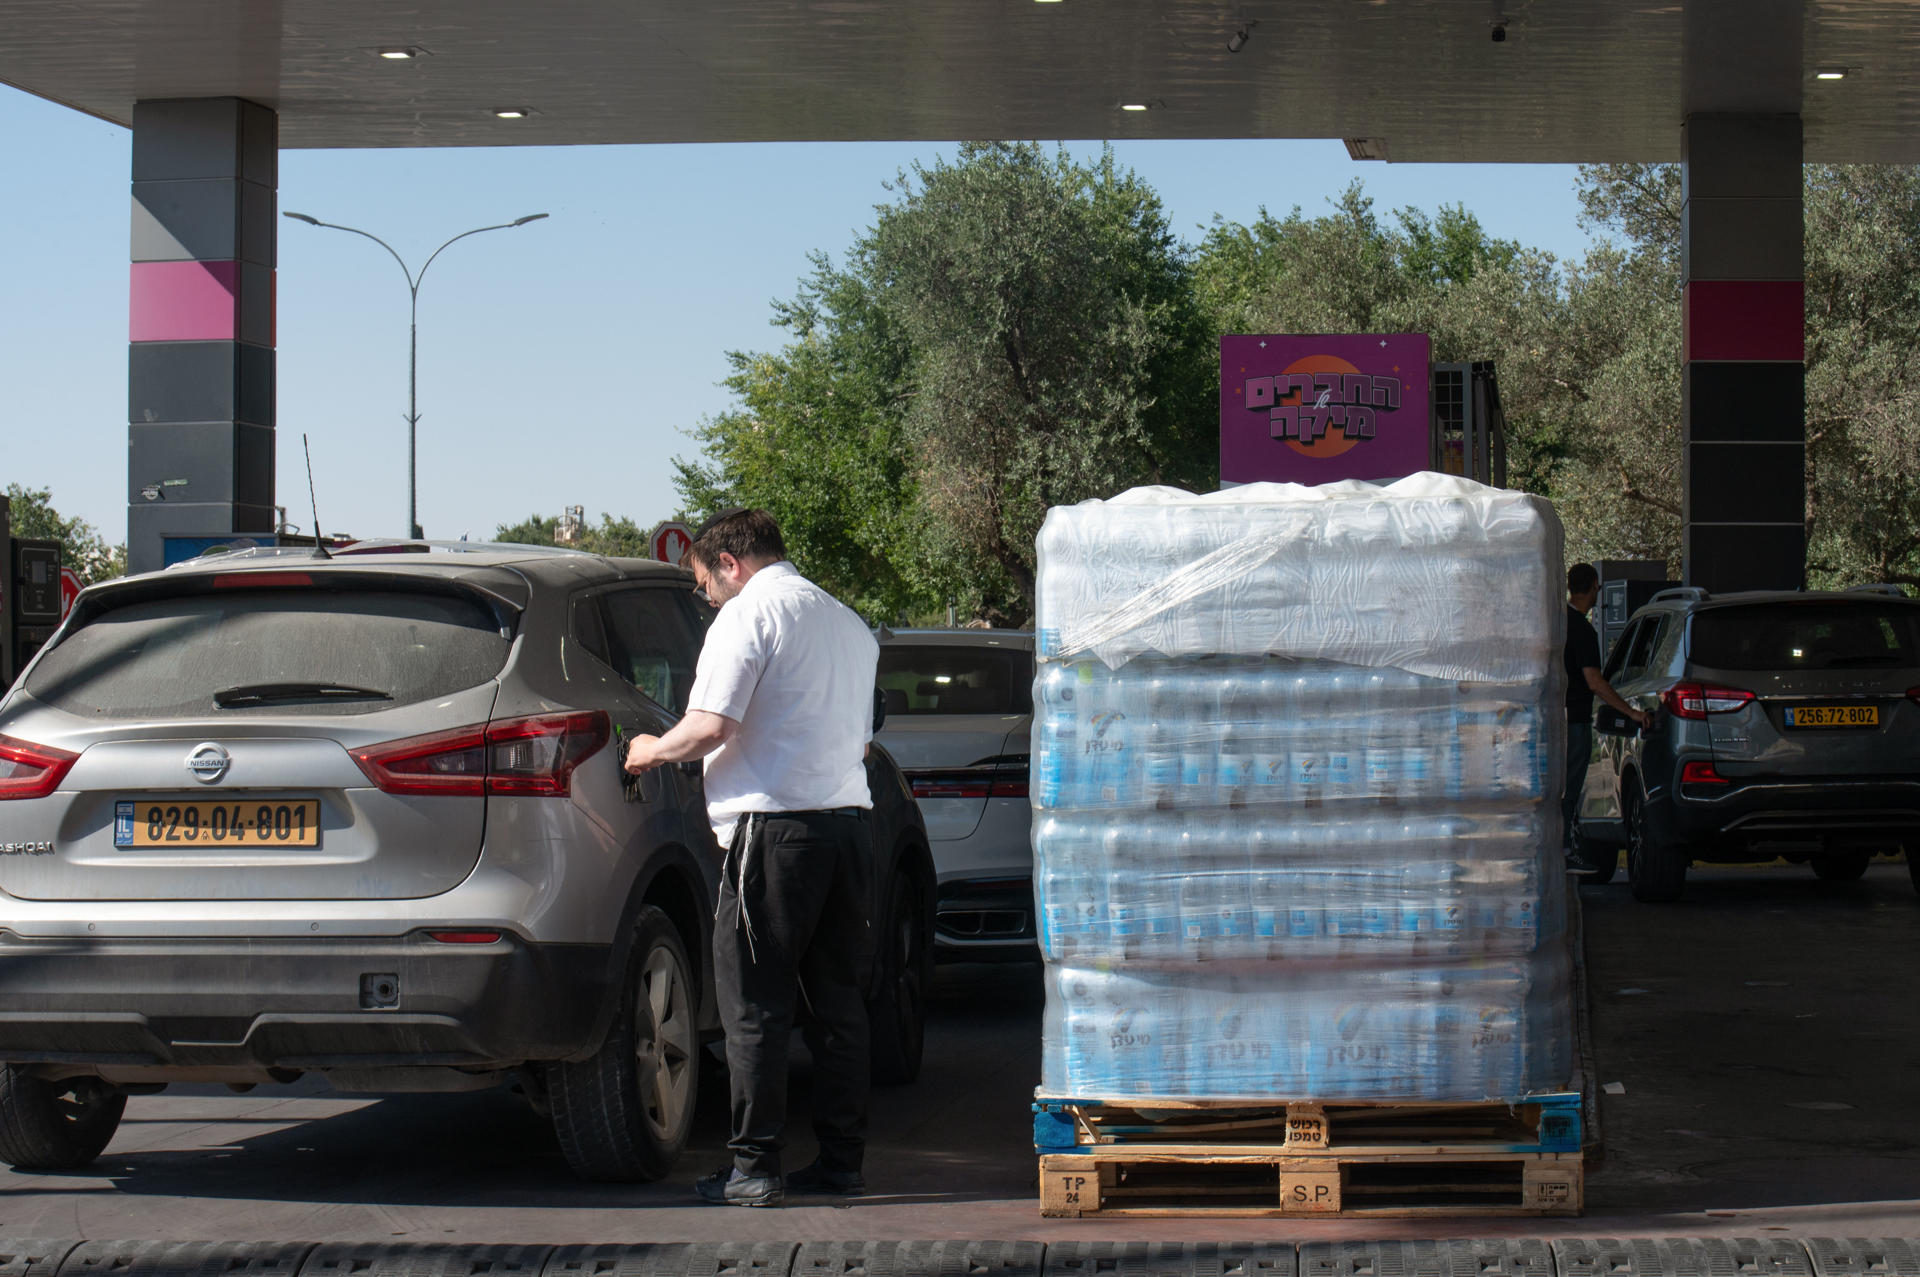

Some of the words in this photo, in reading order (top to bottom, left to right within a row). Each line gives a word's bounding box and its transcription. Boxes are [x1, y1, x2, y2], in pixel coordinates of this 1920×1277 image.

[1246, 373, 1400, 409] החברים
[1270, 405, 1376, 443] מיקה
[118, 816, 130, 833] IL
[1290, 1119, 1321, 1130] רכוש
[1289, 1132, 1321, 1142] טמפו
[1294, 1185, 1332, 1202] S.P.
